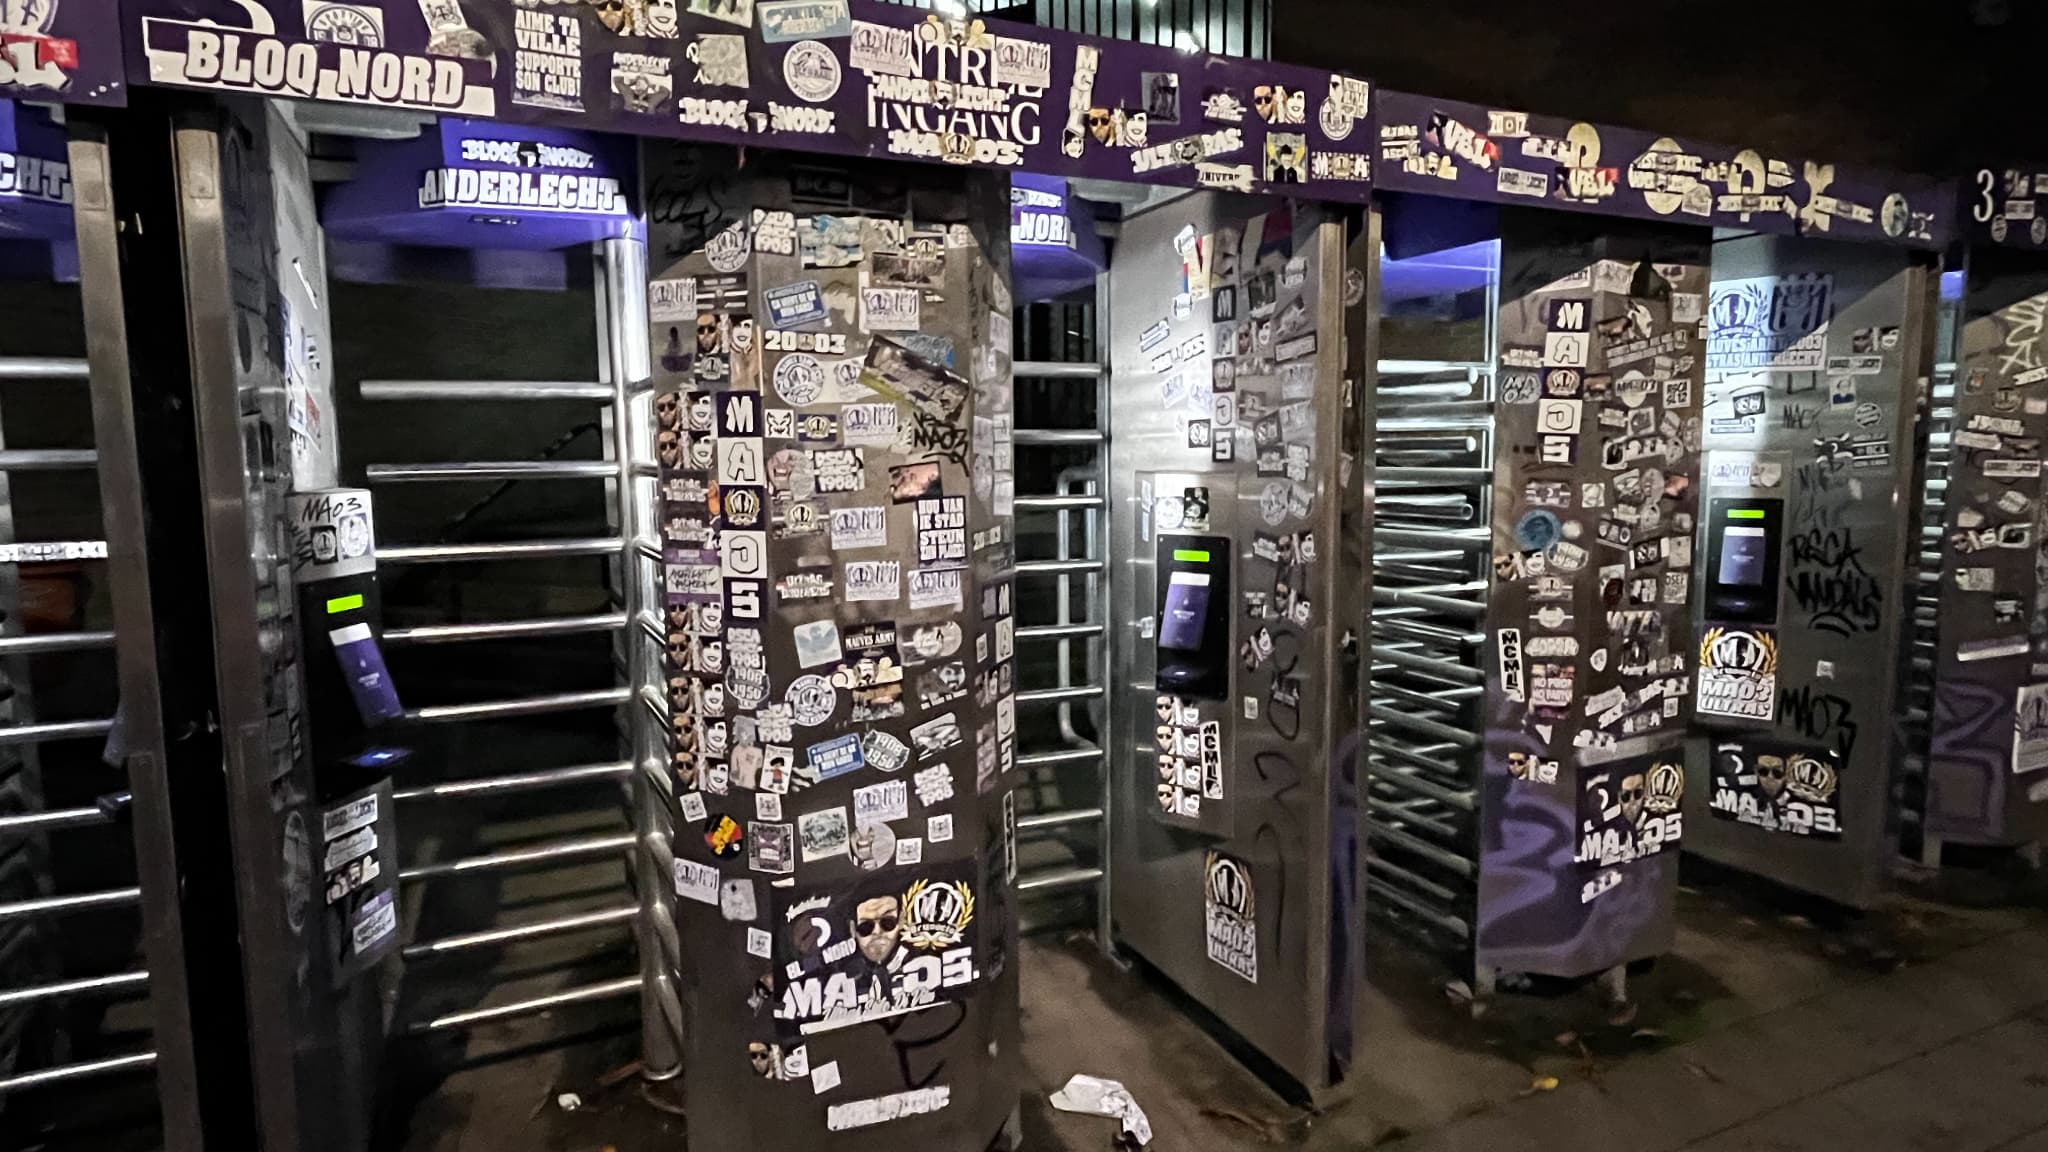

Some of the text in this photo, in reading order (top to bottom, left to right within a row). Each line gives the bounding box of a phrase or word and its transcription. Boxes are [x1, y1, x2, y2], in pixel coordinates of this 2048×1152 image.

[515, 9, 580, 37] AIME TA
[516, 30, 581, 56] VILLE
[185, 30, 466, 108] BLOQ NORD
[515, 50, 582, 77] SUPPORTE
[515, 71, 541, 92] SON
[423, 169, 622, 212] ANDERLECHT
[1974, 169, 1995, 223] 3
[934, 513, 965, 529] STAD
[920, 530, 965, 546] STEUN
